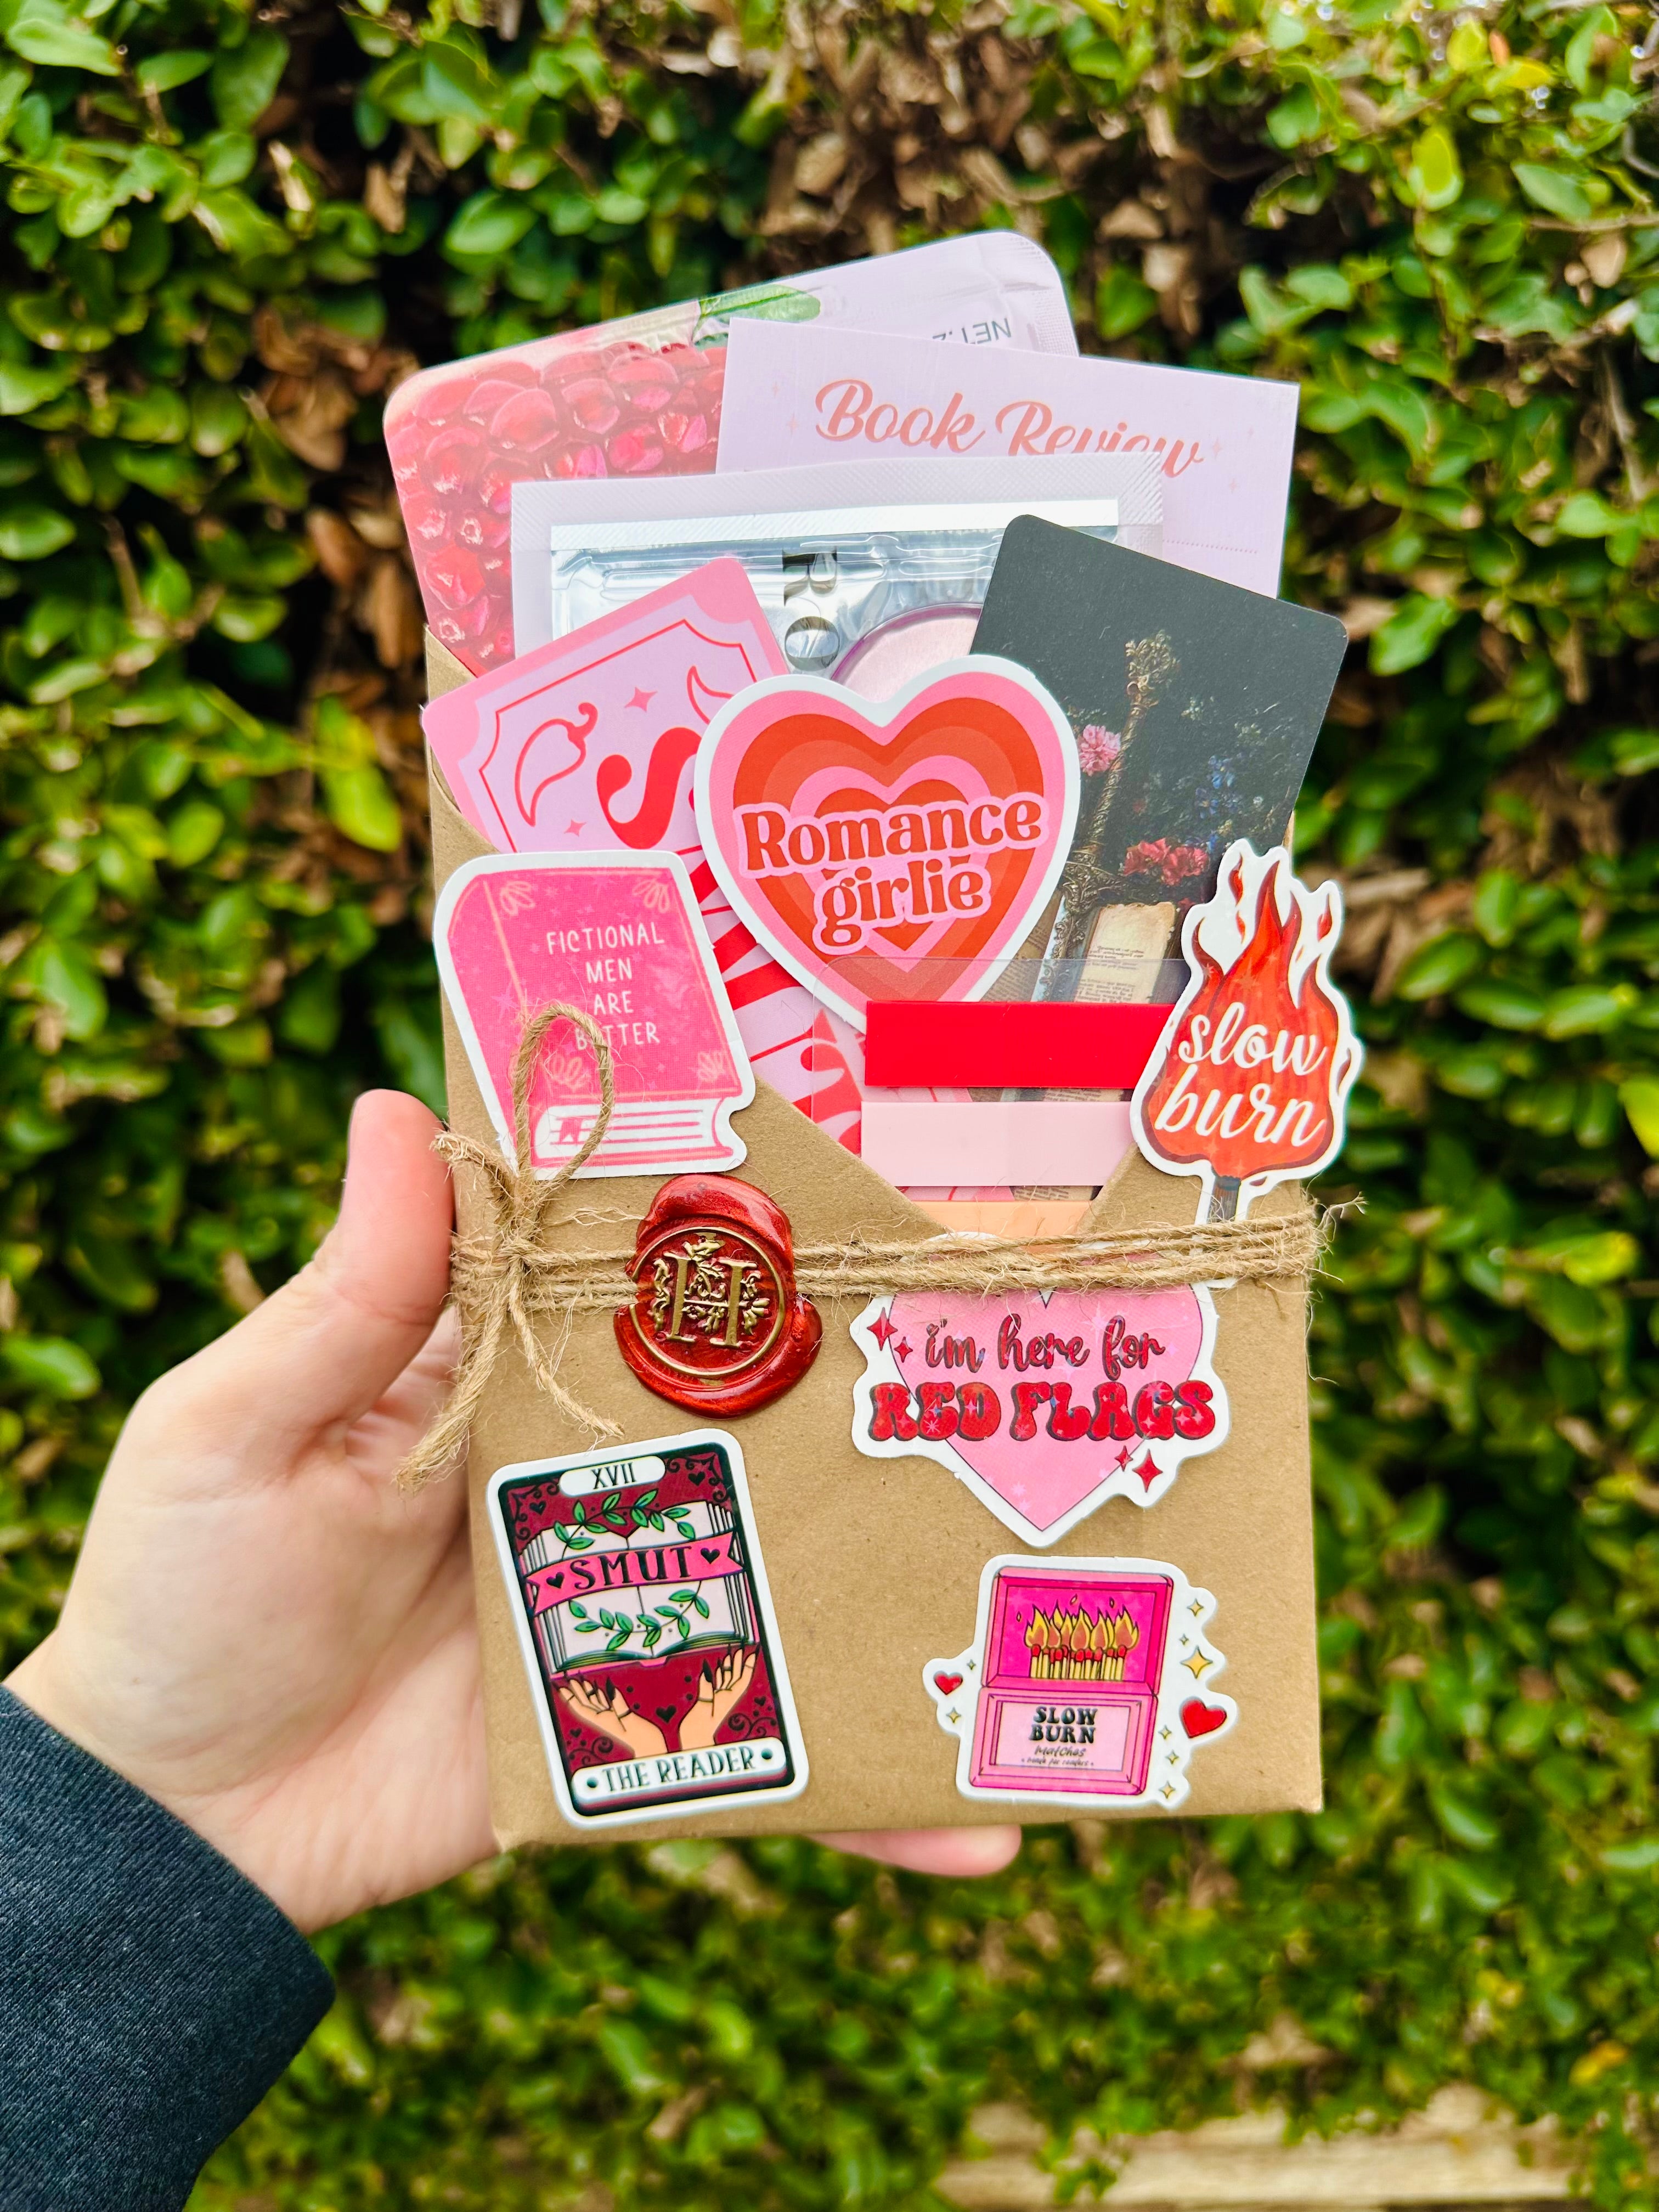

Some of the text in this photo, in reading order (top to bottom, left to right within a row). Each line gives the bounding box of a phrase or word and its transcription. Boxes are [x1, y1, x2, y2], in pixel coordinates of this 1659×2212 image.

[815, 379, 985, 453] Book
[741, 799, 1042, 871] Romance
[820, 857, 984, 947] girlie
[546, 922, 665, 955] FICTIONAL
[585, 958, 633, 984] MEN
[594, 990, 634, 1015] ARE
[574, 1021, 661, 1051] BTTER
[1178, 1002, 1329, 1076] slow
[1154, 1064, 1327, 1147] burn
[997, 1313, 1090, 1373] here
[1102, 1314, 1166, 1381] for
[867, 1380, 1216, 1442] RED FLAGS
[590, 1462, 636, 1491] XVII
[569, 1545, 694, 1591] SMUT
[1028, 1724, 1096, 1743] BURN
[1033, 1706, 1098, 1725] SLOW
[601, 1746, 757, 1792] THE READER
